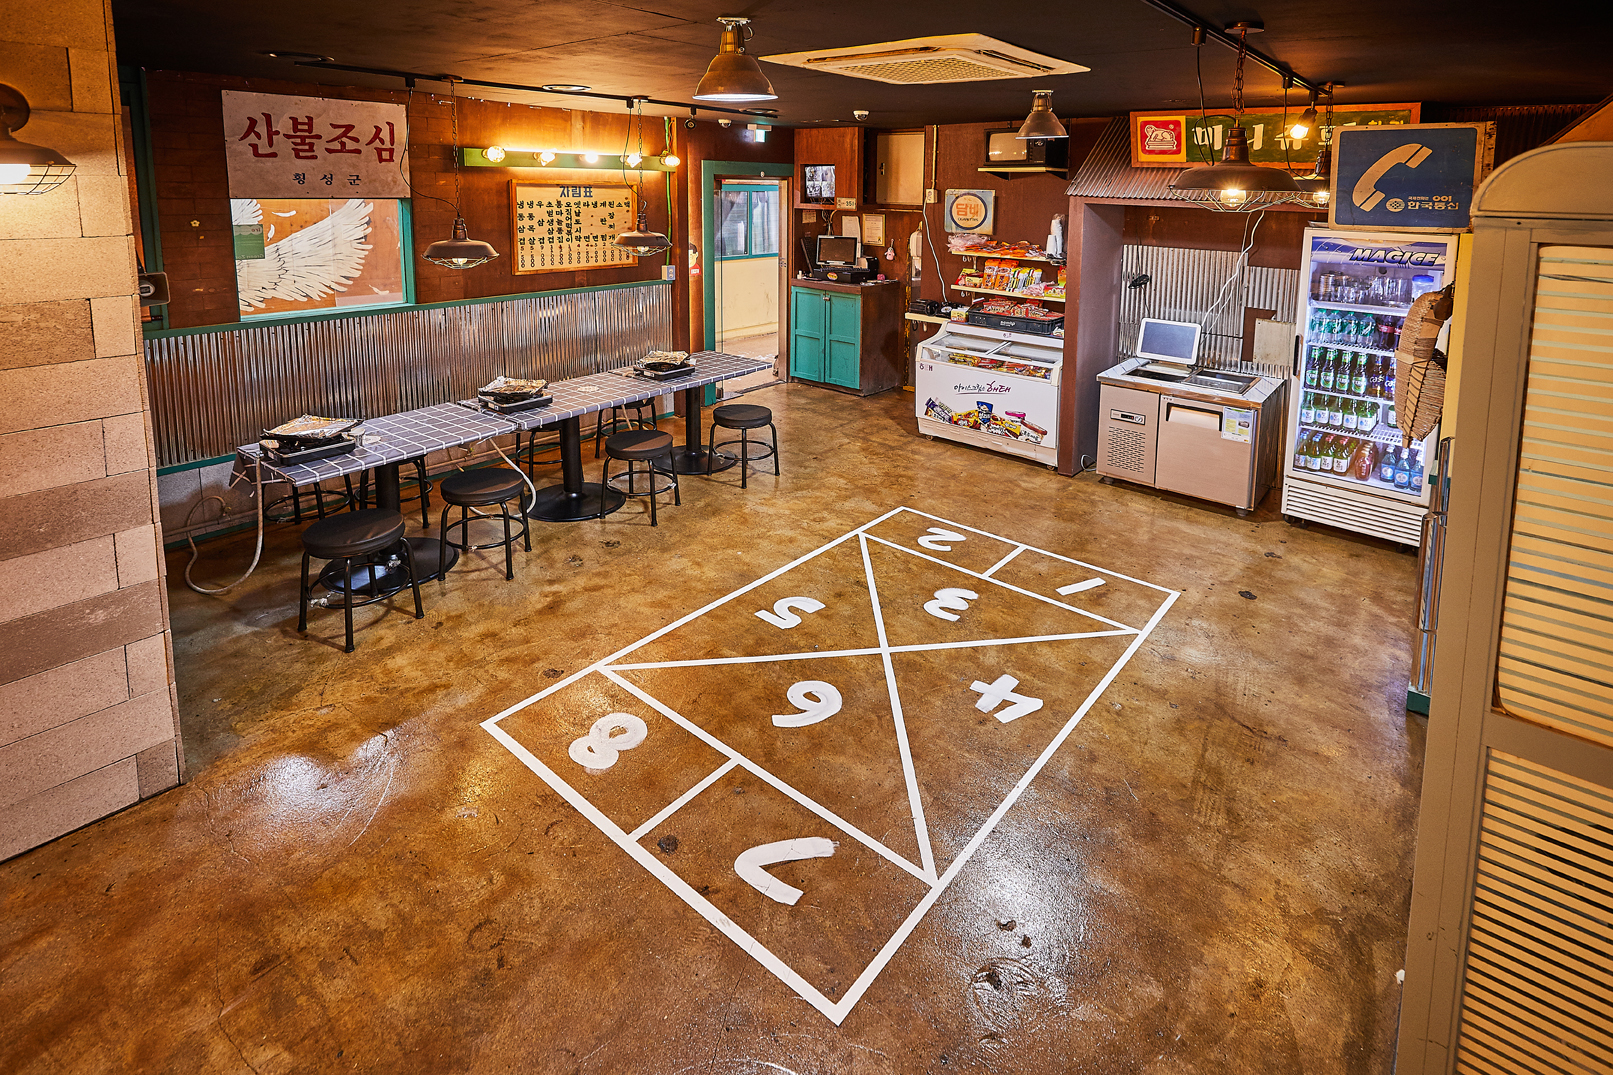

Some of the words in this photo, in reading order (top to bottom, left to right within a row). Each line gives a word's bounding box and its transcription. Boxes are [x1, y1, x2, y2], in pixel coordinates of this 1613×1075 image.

[238, 112, 396, 164] 산불조심
[292, 172, 362, 186] 횡성군
[559, 185, 593, 198] 차림표
[1407, 201, 1459, 210] 한국통신
[1350, 247, 1440, 267] MAGICE
[917, 526, 968, 552] 2
[753, 596, 826, 631] 5
[922, 586, 979, 621] 3
[771, 680, 843, 728] 6
[968, 674, 1044, 724] 4
[567, 712, 649, 774] 8
[732, 836, 840, 906] 7
